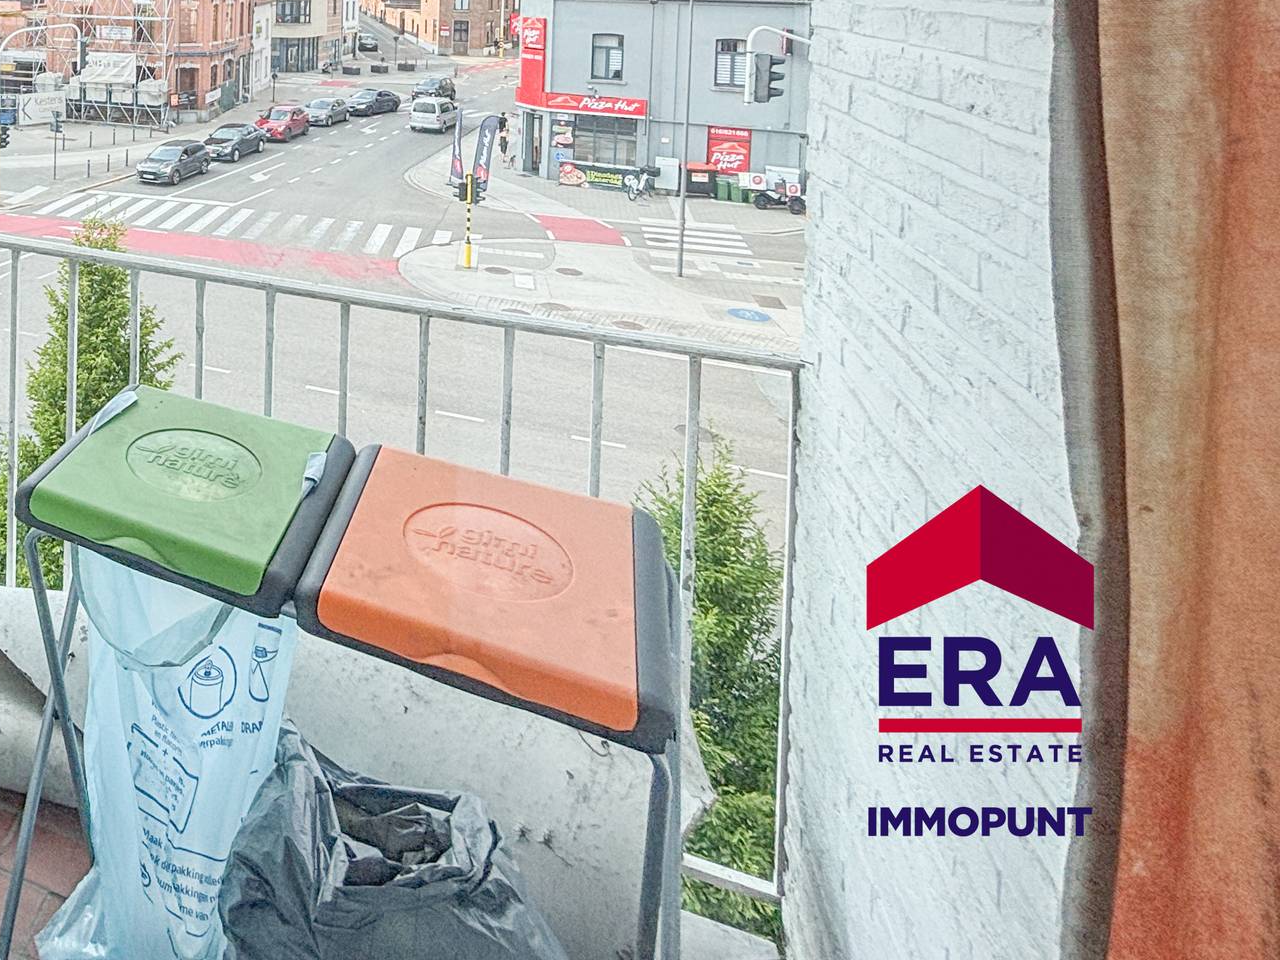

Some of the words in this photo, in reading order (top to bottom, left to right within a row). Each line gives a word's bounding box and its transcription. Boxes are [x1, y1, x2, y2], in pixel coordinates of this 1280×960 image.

[579, 97, 613, 109] Pizza
[614, 100, 640, 111] Hut
[711, 152, 745, 163] Pizza
[717, 161, 743, 171] Hut
[174, 447, 239, 471] gimi
[147, 455, 240, 488] nature
[461, 529, 537, 559] gimi
[431, 541, 554, 584] nature
